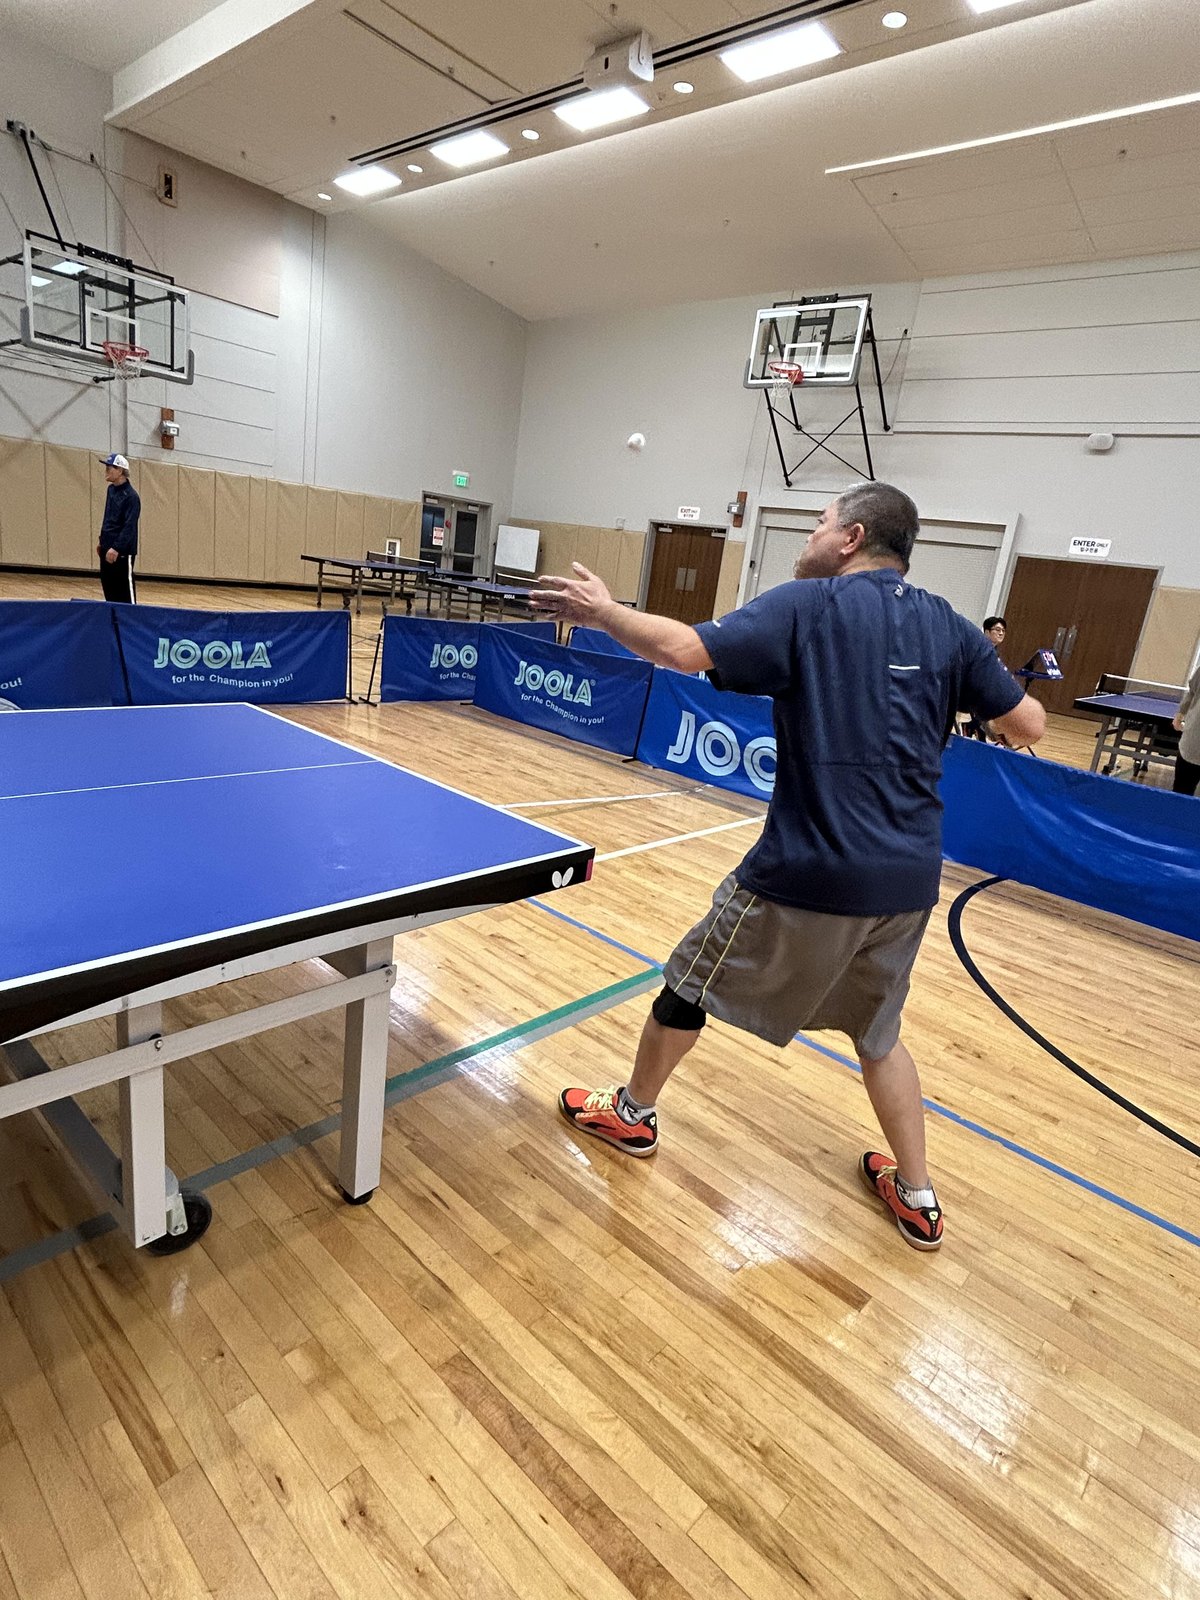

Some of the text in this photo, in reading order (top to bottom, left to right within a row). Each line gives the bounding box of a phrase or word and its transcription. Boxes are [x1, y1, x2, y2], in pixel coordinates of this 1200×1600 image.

[1073, 539, 1096, 548] ENTER
[429, 643, 479, 669] JOO
[0, 676, 23, 690] ou!
[172, 673, 294, 688] for the Champion in you!
[520, 693, 605, 726] for the Champion in you!
[666, 709, 778, 793] JOO
